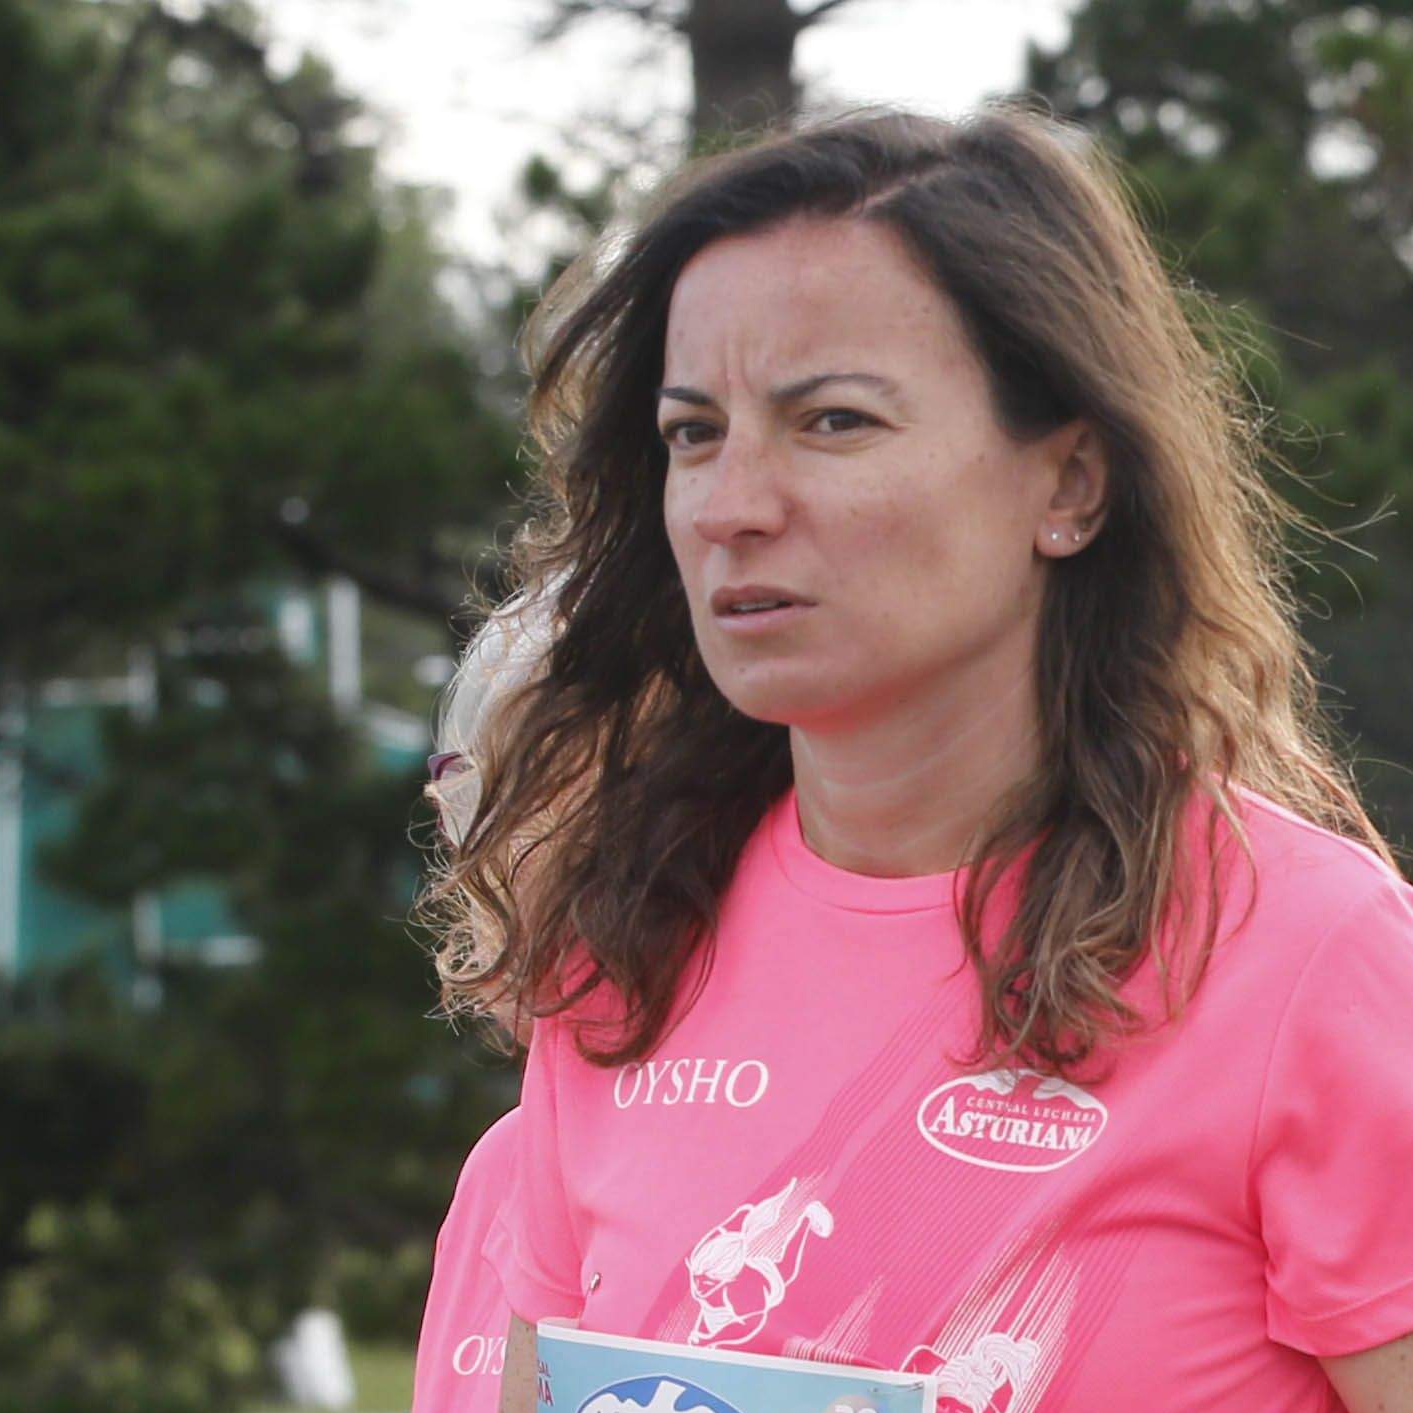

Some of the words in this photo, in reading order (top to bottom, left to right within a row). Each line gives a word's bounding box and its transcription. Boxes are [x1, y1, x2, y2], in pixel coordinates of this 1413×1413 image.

[612, 1058, 770, 1110] OYSHO
[966, 1096, 1028, 1115] CENTRAL
[928, 1095, 1092, 1150] ASTURIANA
[452, 1334, 507, 1377] OYS
